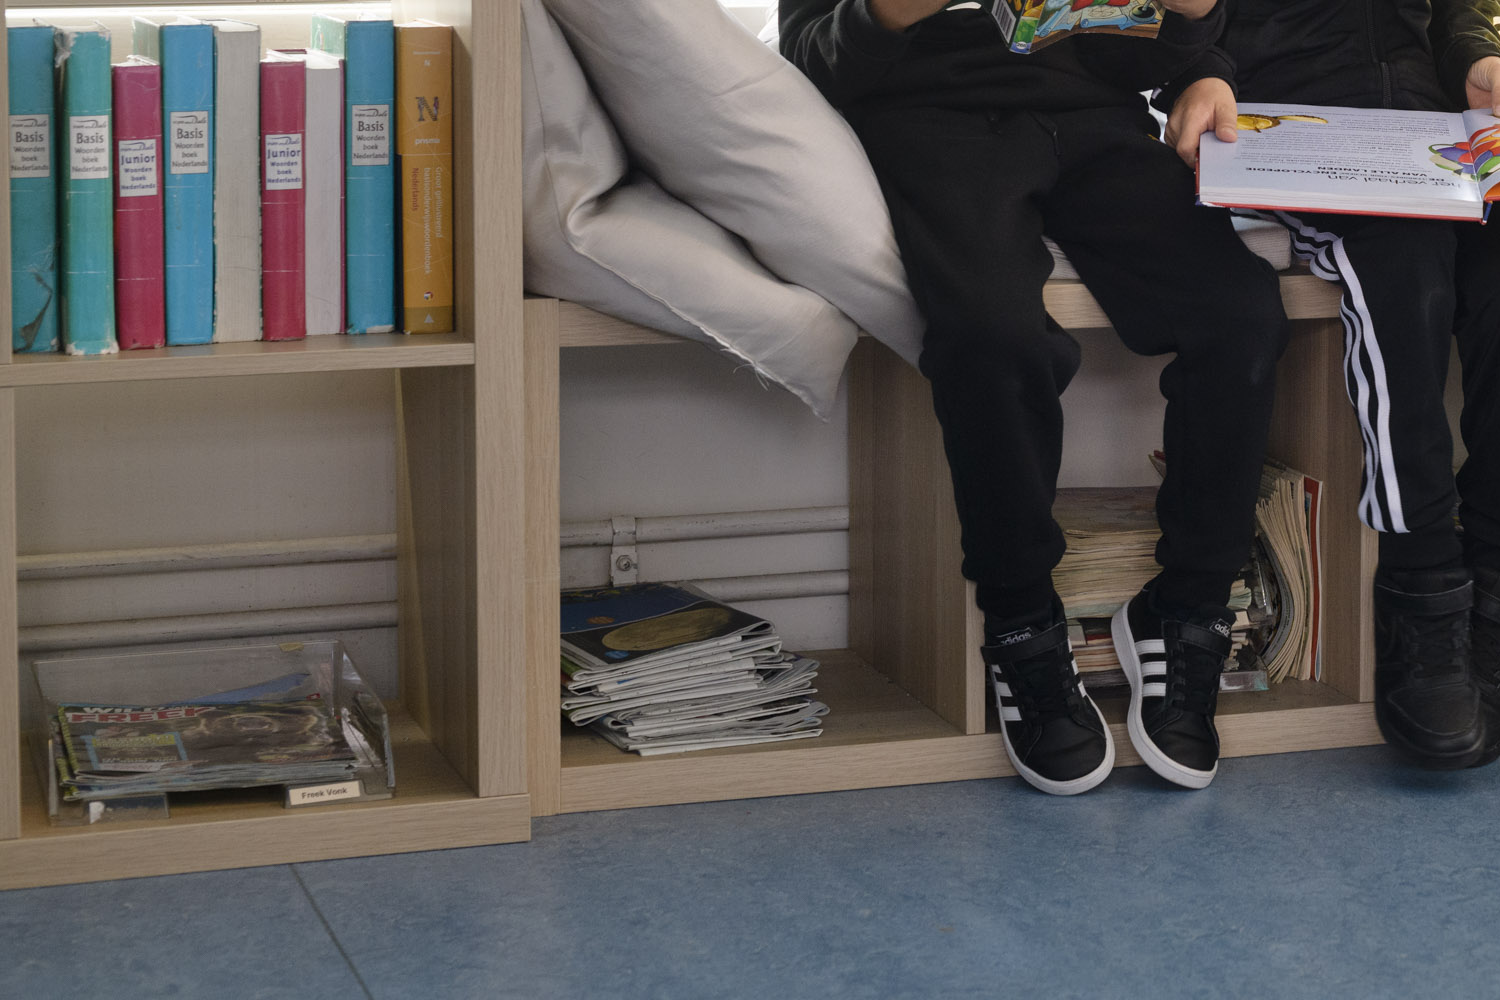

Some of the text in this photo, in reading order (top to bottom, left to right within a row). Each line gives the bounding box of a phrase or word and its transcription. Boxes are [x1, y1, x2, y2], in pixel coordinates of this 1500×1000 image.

[416, 96, 439, 121] N
[358, 120, 384, 131] Basis
[15, 131, 44, 143] Basis
[76, 132, 104, 144] Basis
[176, 128, 203, 139] Basis
[267, 147, 301, 159] Junior
[120, 154, 155, 165] Junior
[1245, 167, 1337, 175] ENCYCLOPEDIE
[1364, 177, 1427, 185] verhaal
[411, 167, 420, 212] Nederlands
[66, 707, 216, 724] FREEK
[301, 787, 347, 799] Freek Vonk
